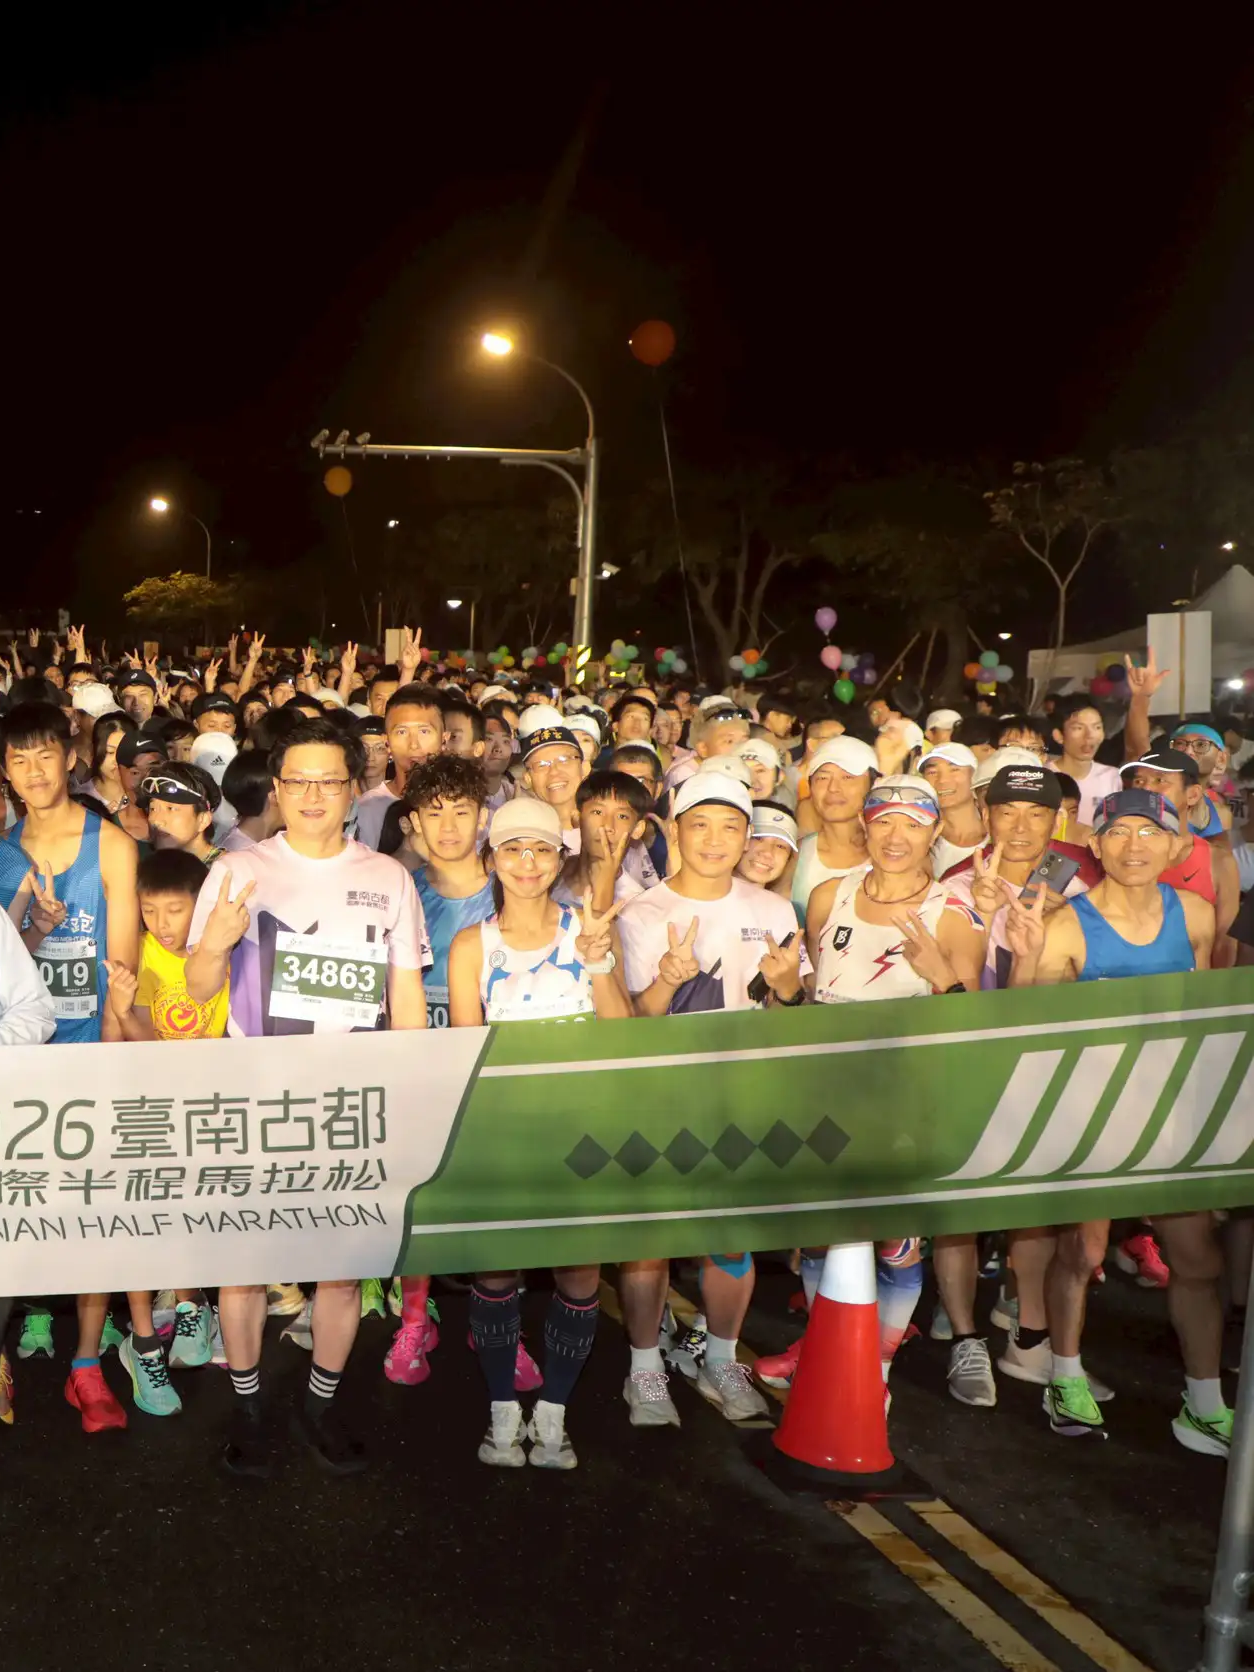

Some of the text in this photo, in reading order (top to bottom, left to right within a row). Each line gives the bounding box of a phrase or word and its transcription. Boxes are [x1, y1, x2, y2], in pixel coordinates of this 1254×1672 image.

[281, 955, 376, 992] 34863
[77, 1213, 173, 1239] HALF
[182, 1202, 387, 1235] MARATHON
